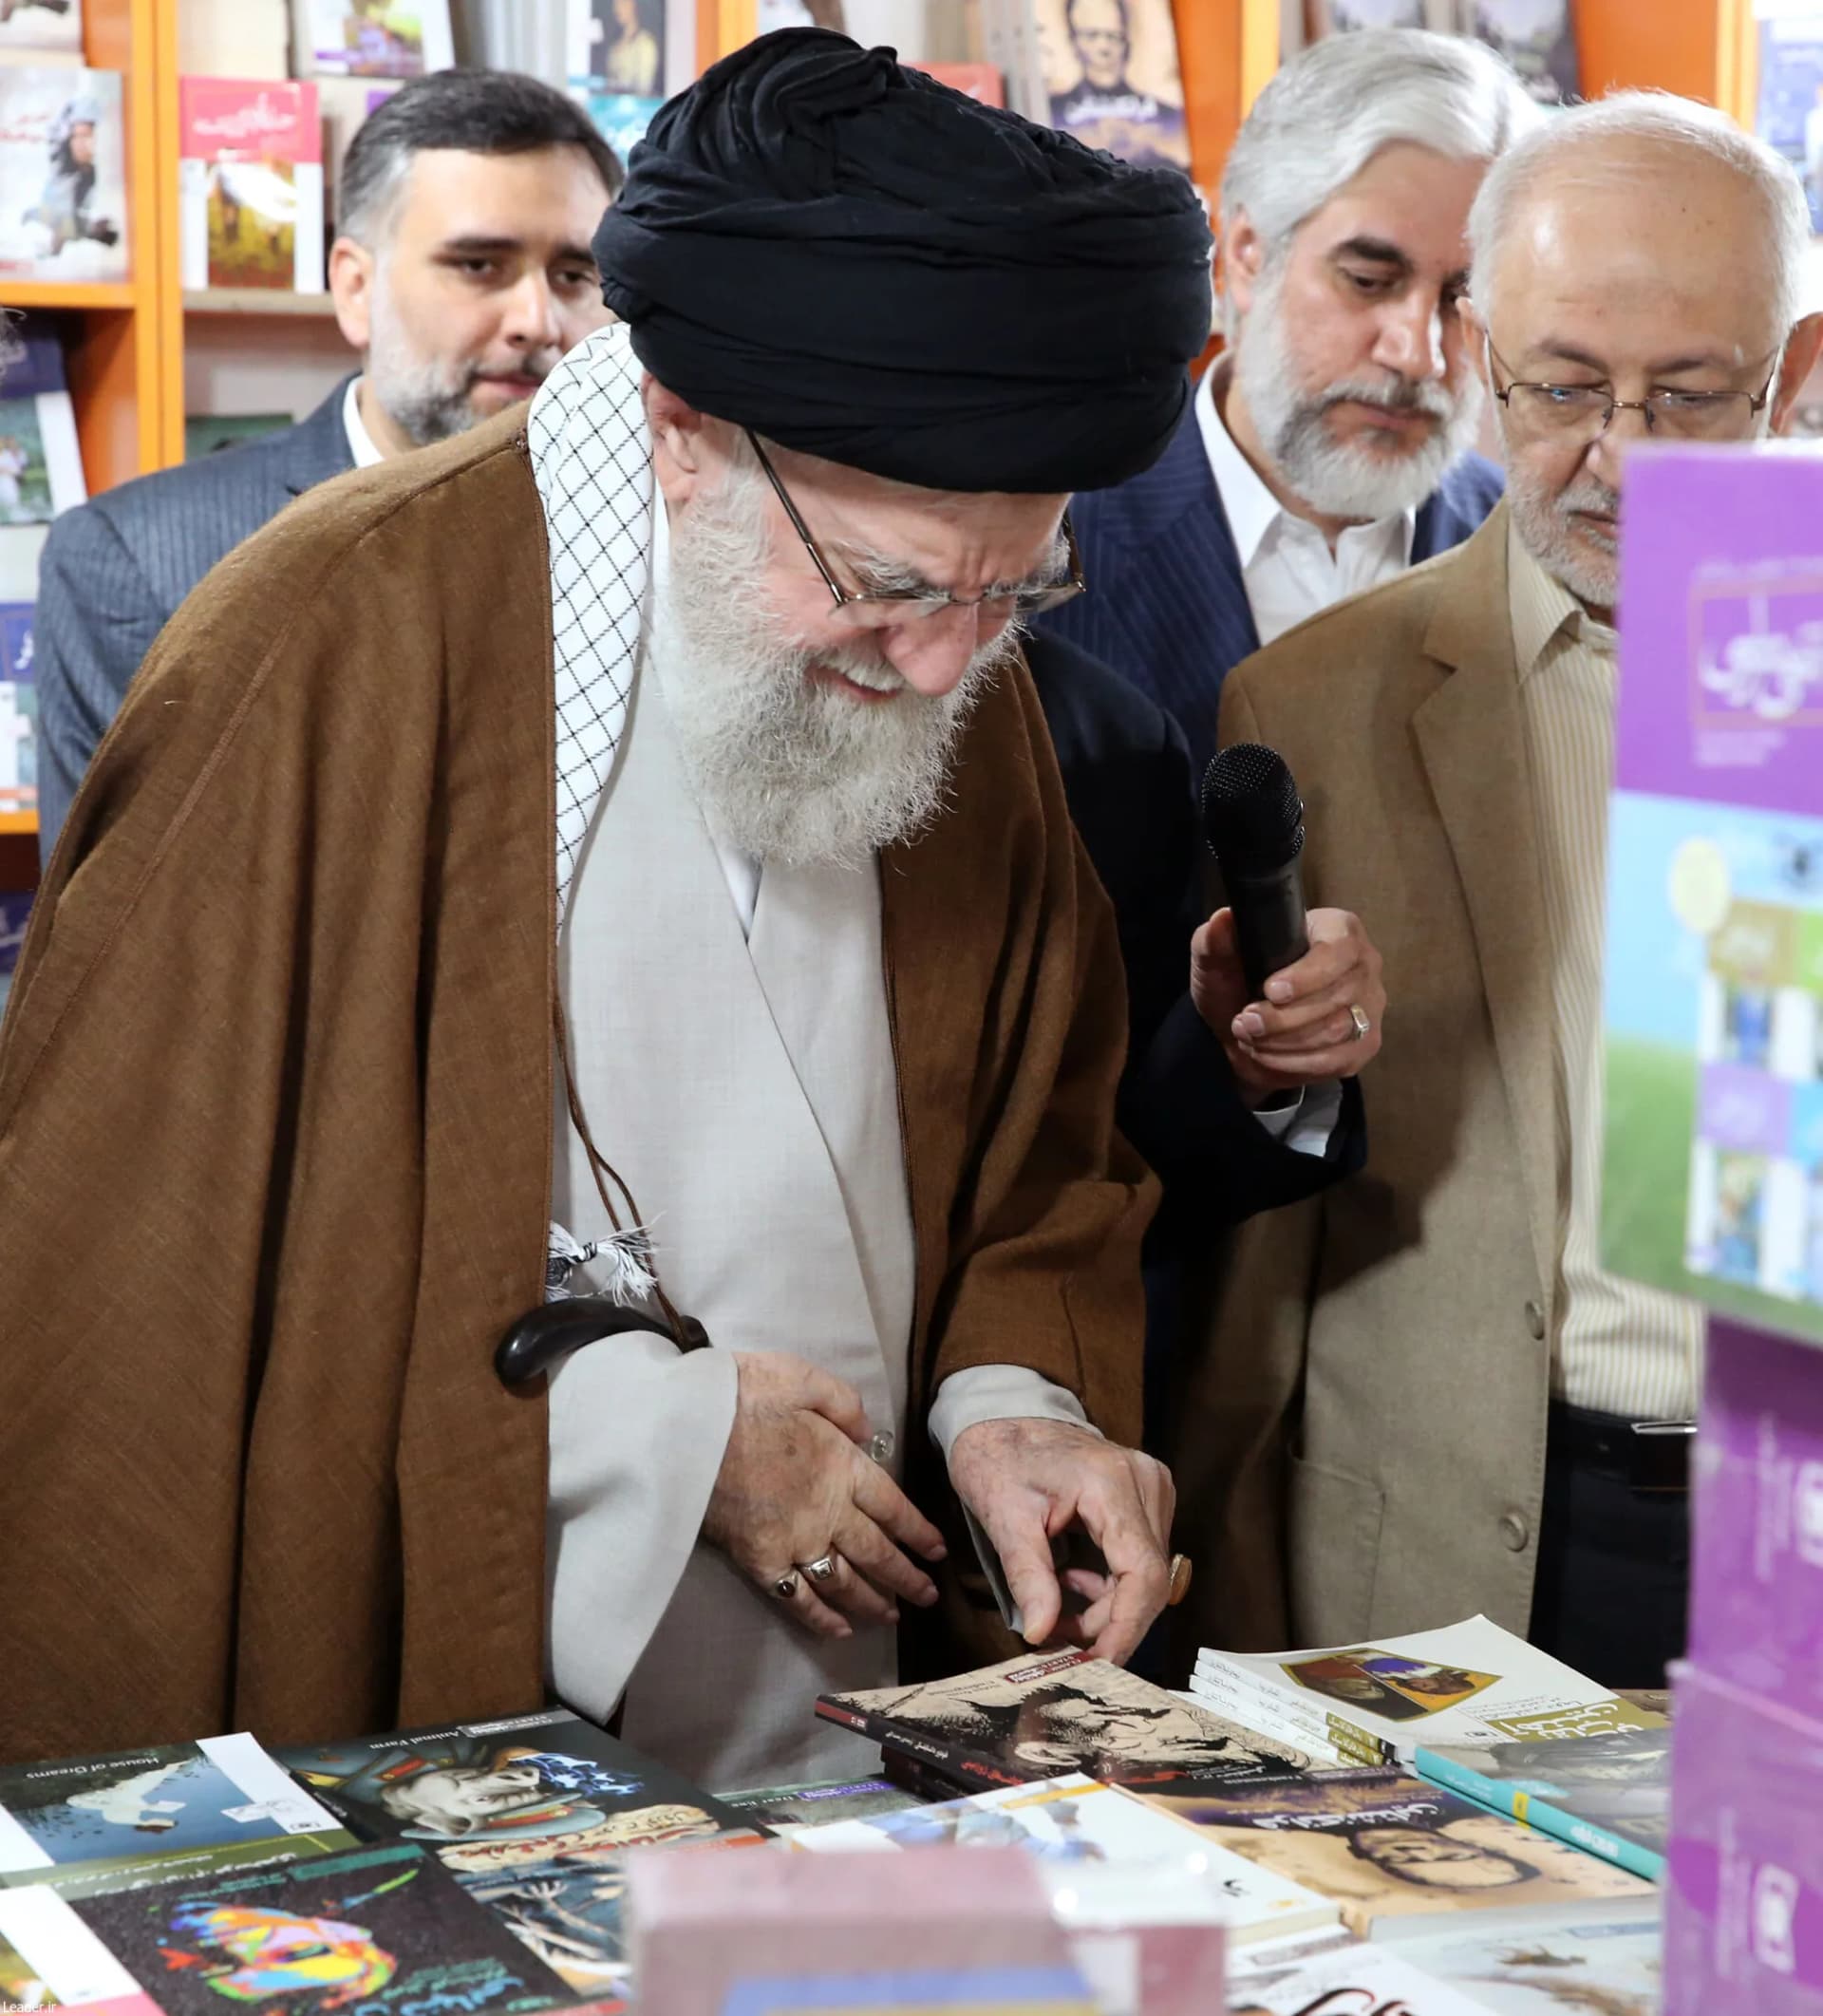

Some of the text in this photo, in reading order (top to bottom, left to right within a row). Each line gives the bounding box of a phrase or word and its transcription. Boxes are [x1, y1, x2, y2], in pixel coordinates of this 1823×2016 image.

[368, 1729, 460, 1751] Animal Farm
[26, 1756, 160, 1780] House of Dreams
